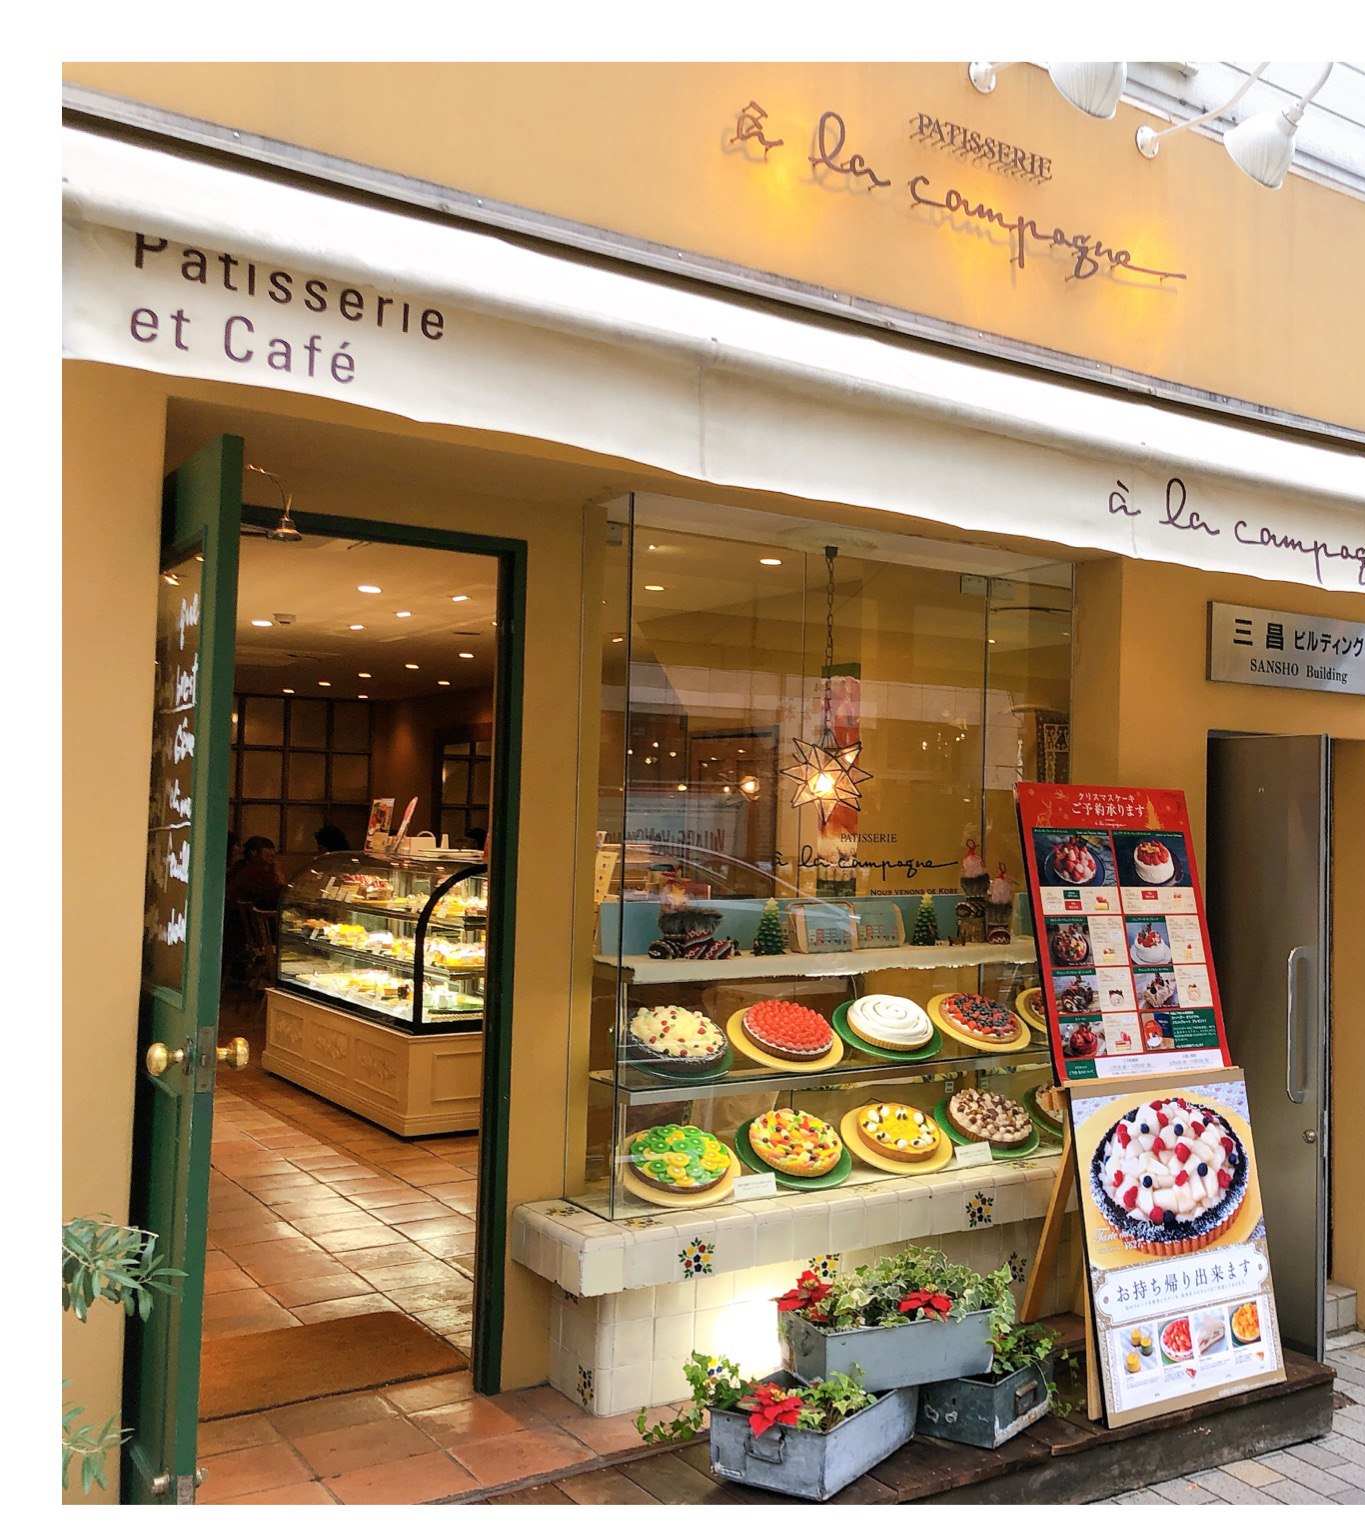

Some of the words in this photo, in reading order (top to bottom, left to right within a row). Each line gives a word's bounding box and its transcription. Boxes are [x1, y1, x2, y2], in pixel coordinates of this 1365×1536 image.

[916, 112, 1053, 181] PATISSERIE
[808, 111, 891, 188] la
[910, 174, 1187, 280] campagne
[130, 308, 191, 352] et
[224, 314, 357, 384] Café
[1108, 479, 1141, 518] à
[1158, 477, 1221, 536] la
[1250, 659, 1299, 676] SANSHO
[1306, 665, 1348, 684] Building
[840, 832, 897, 844] PATISSERIE
[837, 857, 959, 881] campagne
[1116, 1259, 1251, 1303] お持ち帰り出来ます
